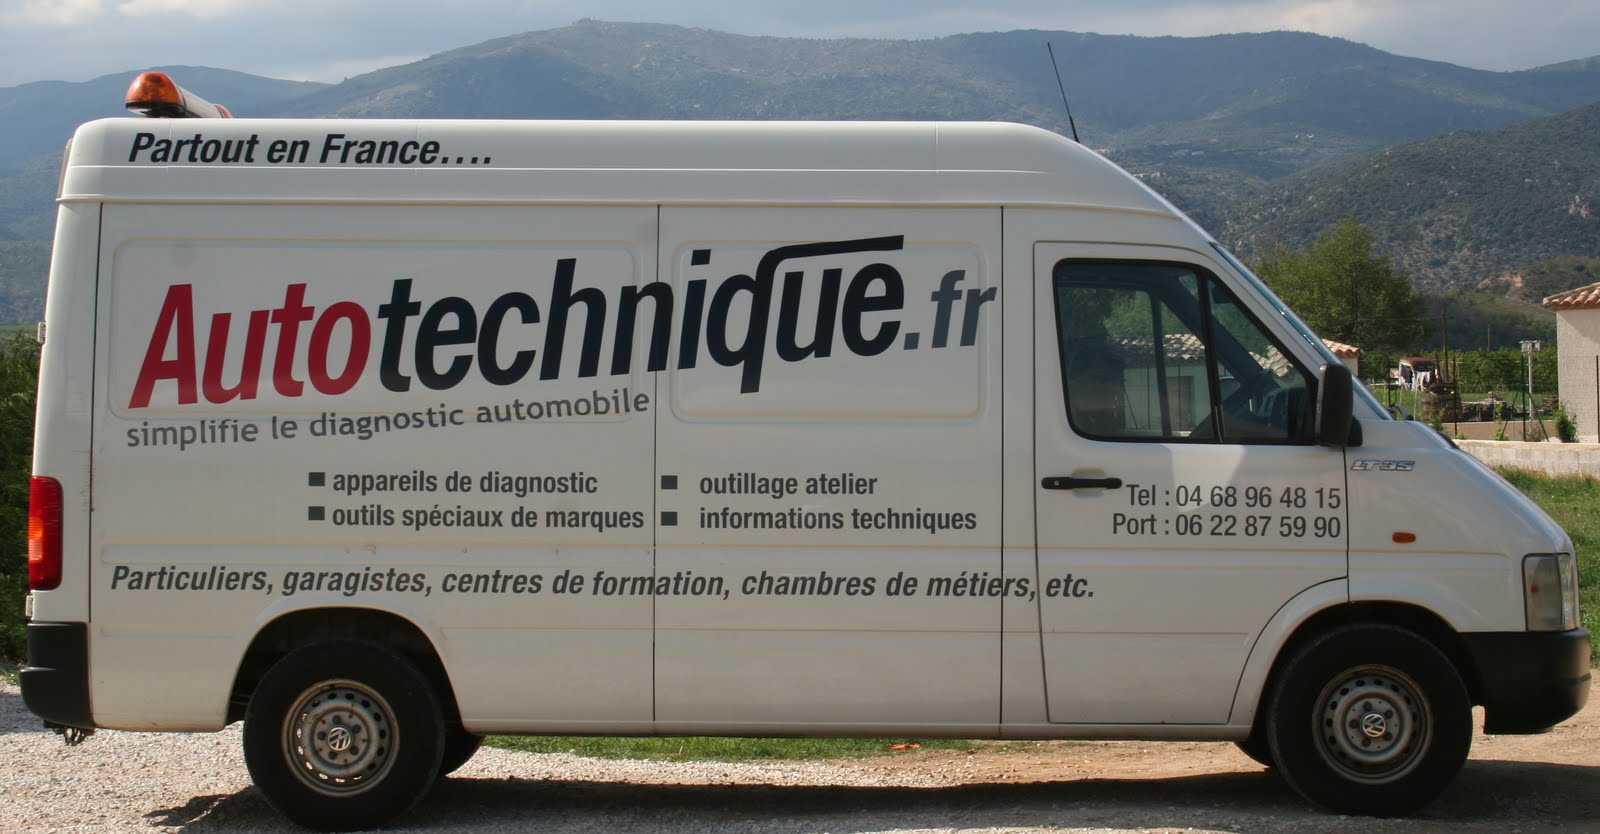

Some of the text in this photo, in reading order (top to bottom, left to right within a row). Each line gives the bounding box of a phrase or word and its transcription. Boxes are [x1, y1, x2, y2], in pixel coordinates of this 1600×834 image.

[128, 132, 260, 164] Partout
[266, 139, 311, 164] en
[128, 234, 998, 409] Autotechnique.fr
[126, 388, 650, 451] simplifie le diagnostic automobile
[1351, 460, 1415, 471] LT 35
[332, 469, 598, 498] appareils de diagnostic
[699, 472, 878, 500] outillage atelier
[1126, 483, 1156, 507] Tel
[1175, 485, 1203, 507] 04
[1210, 485, 1238, 508] 68
[1244, 486, 1273, 508] 96
[1279, 486, 1307, 509] 48
[1315, 487, 1341, 510] 15
[332, 503, 645, 533] outils spéciaux de marques
[700, 506, 977, 535] informations techniques
[1112, 512, 1158, 536] Port
[1175, 513, 1203, 536] 06
[1209, 514, 1237, 537] 22
[1244, 514, 1272, 537] 87
[1279, 515, 1307, 538] 59
[1313, 516, 1341, 539] 90
[110, 565, 1095, 602] Particuliers, garagistes, centres de formation, chambres de métiers, etc.
